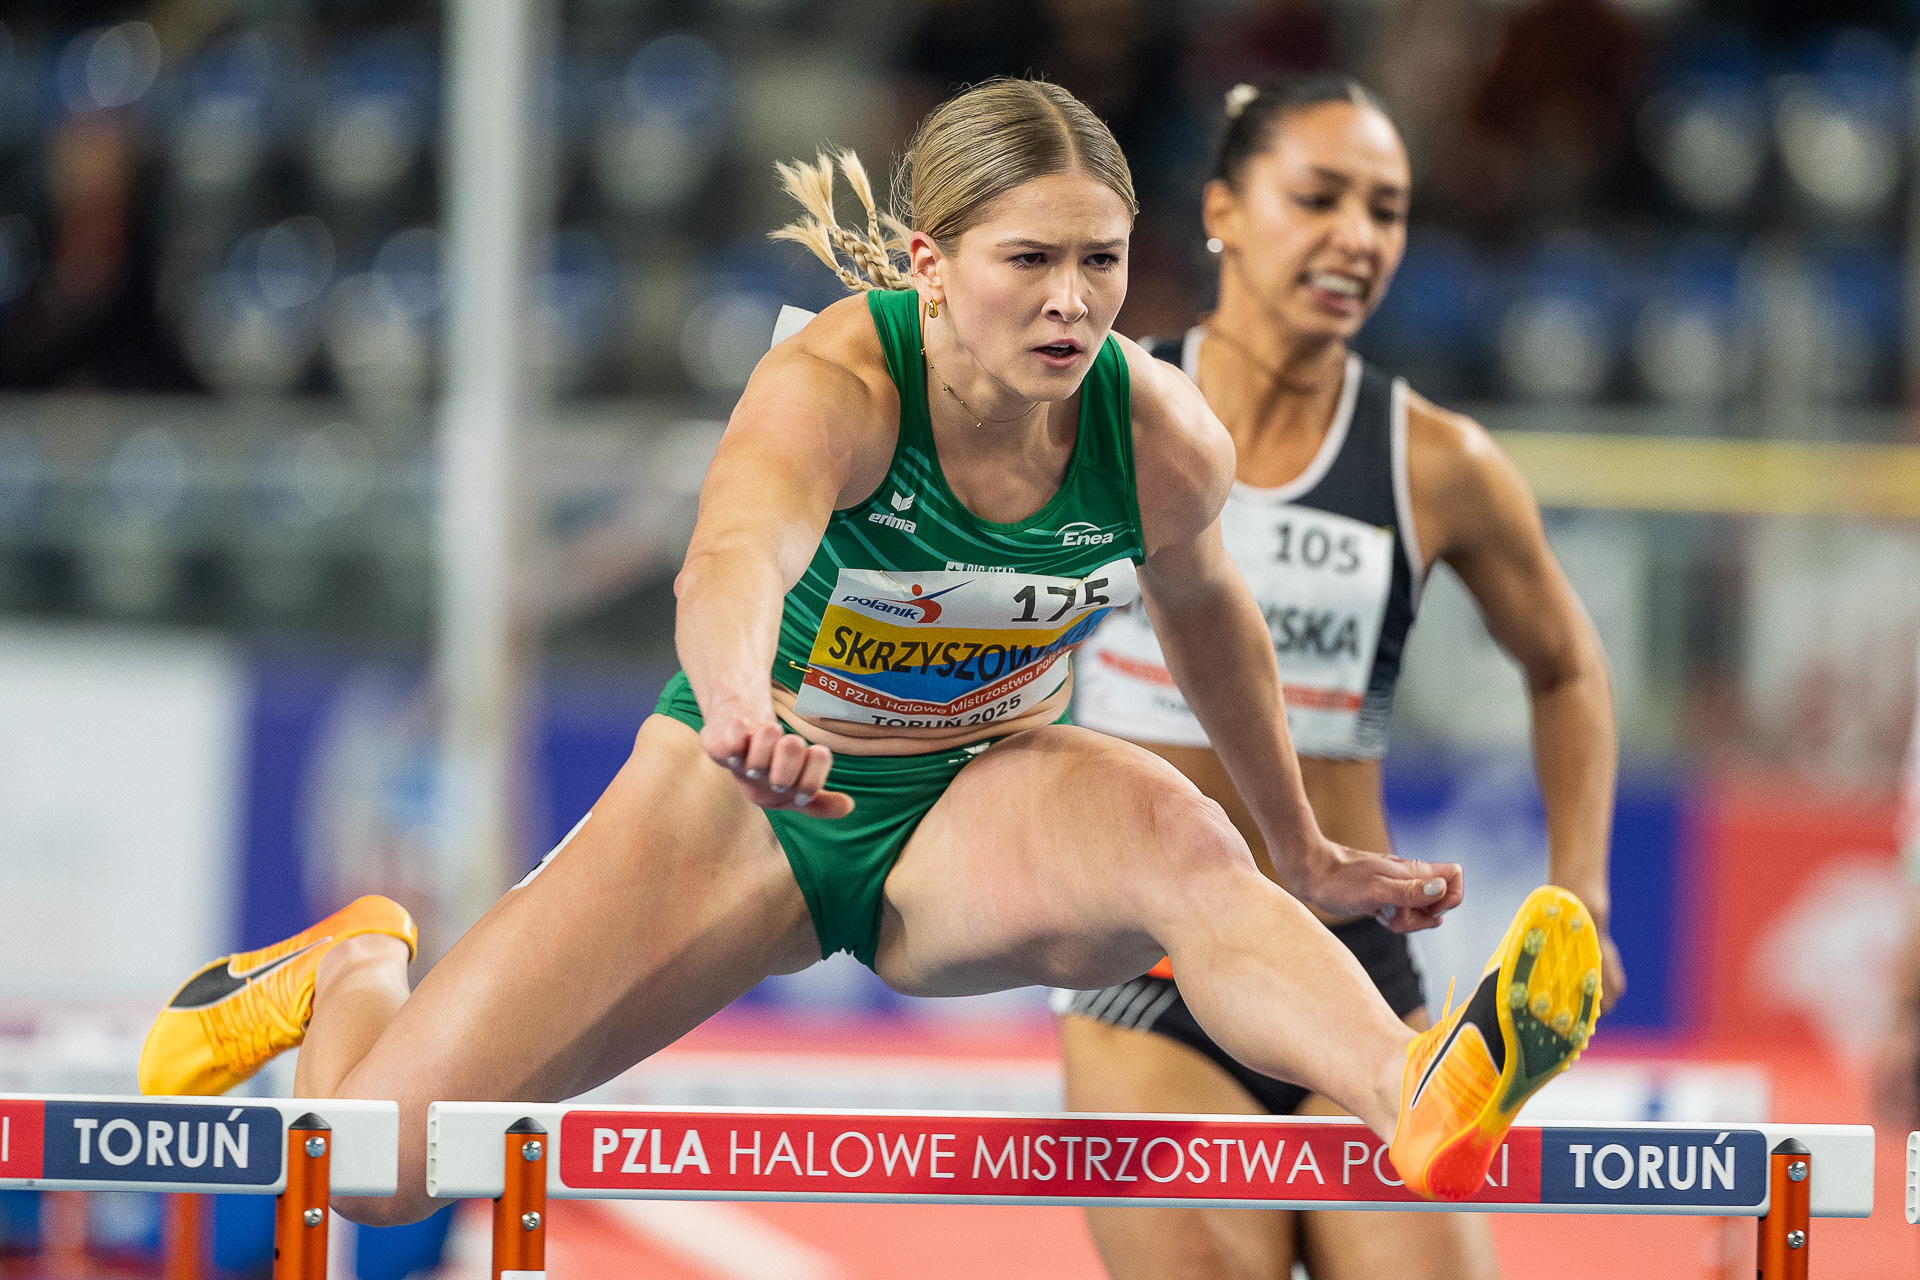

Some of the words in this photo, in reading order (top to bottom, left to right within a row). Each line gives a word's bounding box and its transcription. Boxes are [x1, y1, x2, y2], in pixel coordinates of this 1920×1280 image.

[868, 512, 917, 534] erima
[1061, 531, 1114, 547] Enea
[1275, 522, 1362, 574] 105
[842, 595, 920, 620] polanik
[1010, 577, 1110, 623] 175
[818, 675, 841, 694] 69.
[845, 687, 881, 706] PZLA
[886, 700, 947, 714] Halowe
[950, 671, 1034, 713] Mistrzostwa
[968, 694, 1021, 725] 2025
[73, 1108, 250, 1169] TORUŃ
[592, 1127, 711, 1175] PZLA
[729, 1129, 956, 1179] HALOWE
[971, 1135, 1326, 1185] MISTRZOSTWA
[1569, 1131, 1736, 1190] TORUŃ
